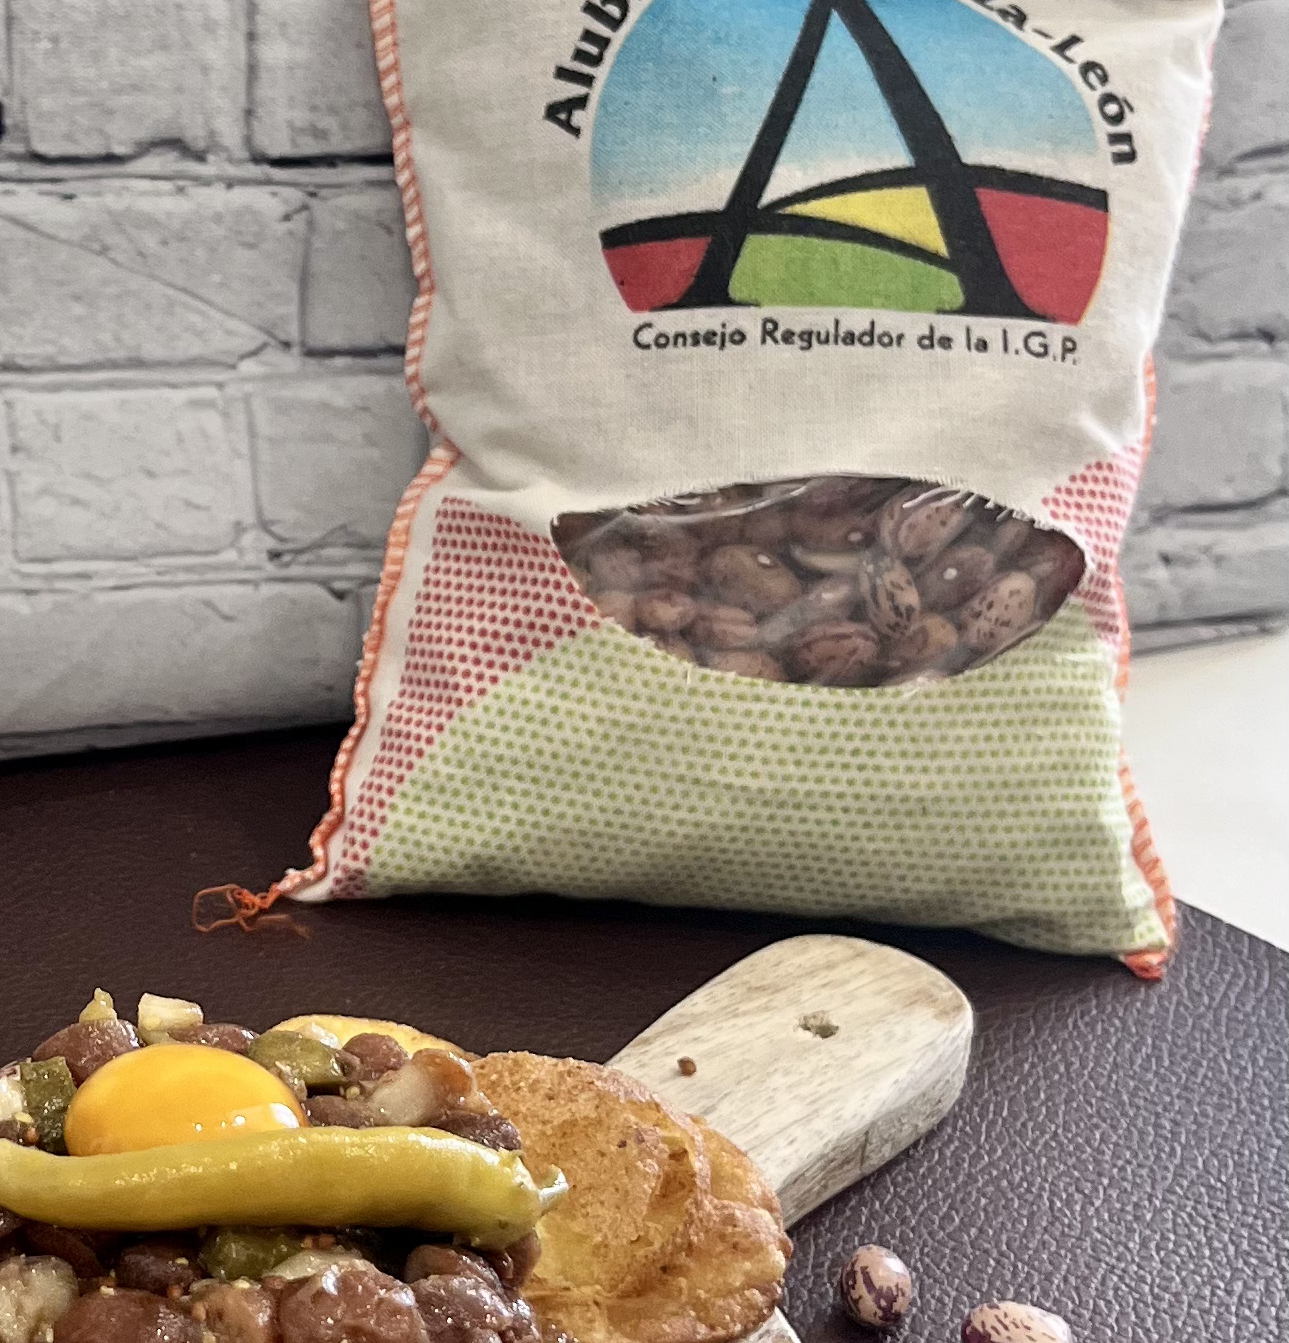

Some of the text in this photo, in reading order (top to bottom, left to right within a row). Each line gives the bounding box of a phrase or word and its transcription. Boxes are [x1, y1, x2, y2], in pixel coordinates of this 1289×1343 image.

[632, 322, 746, 352] Consejo
[760, 317, 904, 352] Regulador
[916, 324, 953, 351] de
[965, 325, 989, 354] la
